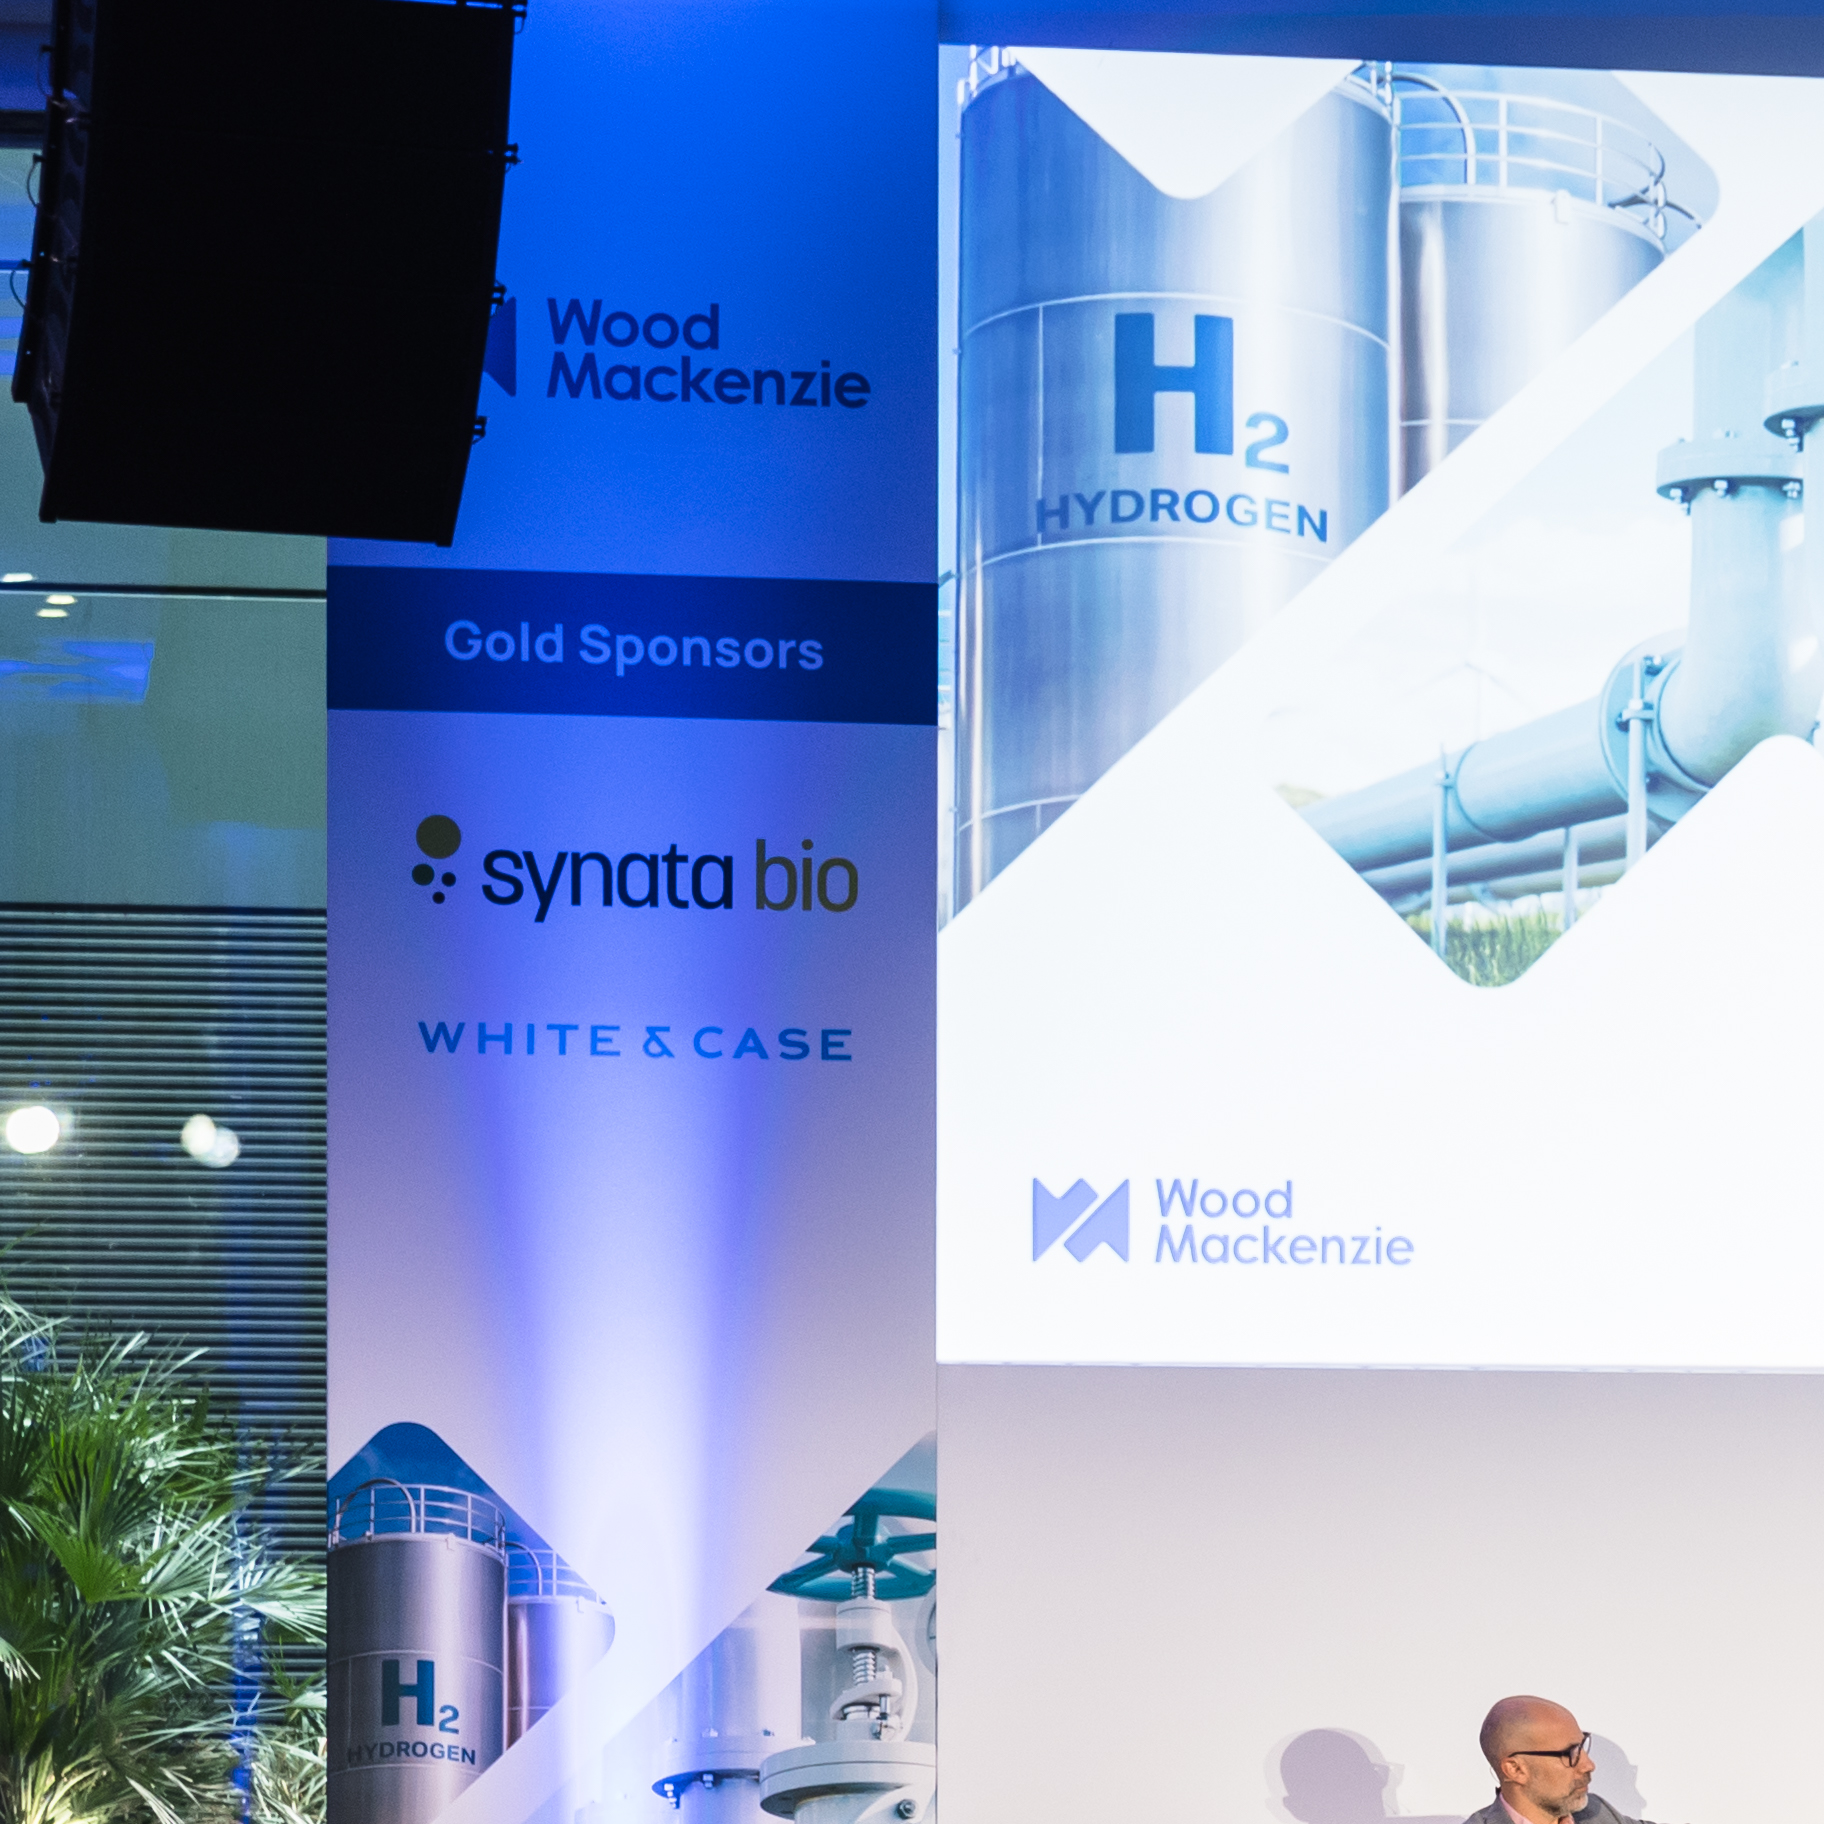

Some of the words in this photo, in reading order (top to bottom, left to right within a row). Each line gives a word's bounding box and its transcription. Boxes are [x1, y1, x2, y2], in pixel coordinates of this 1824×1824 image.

[547, 298, 720, 350] Wood
[547, 351, 871, 408] Mackenzie
[1036, 489, 1327, 543] HYDROGEN
[445, 621, 564, 663] Gold
[580, 625, 823, 676] Sponsors
[482, 844, 733, 923] synata
[756, 839, 858, 912] bio
[418, 1022, 621, 1057] WHITE
[643, 1027, 674, 1058] &
[693, 1026, 852, 1061] CASE
[1155, 1179, 1293, 1218] Wood
[1155, 1225, 1414, 1265] Mackenzie
[347, 1741, 475, 1765] HYDROGEN
